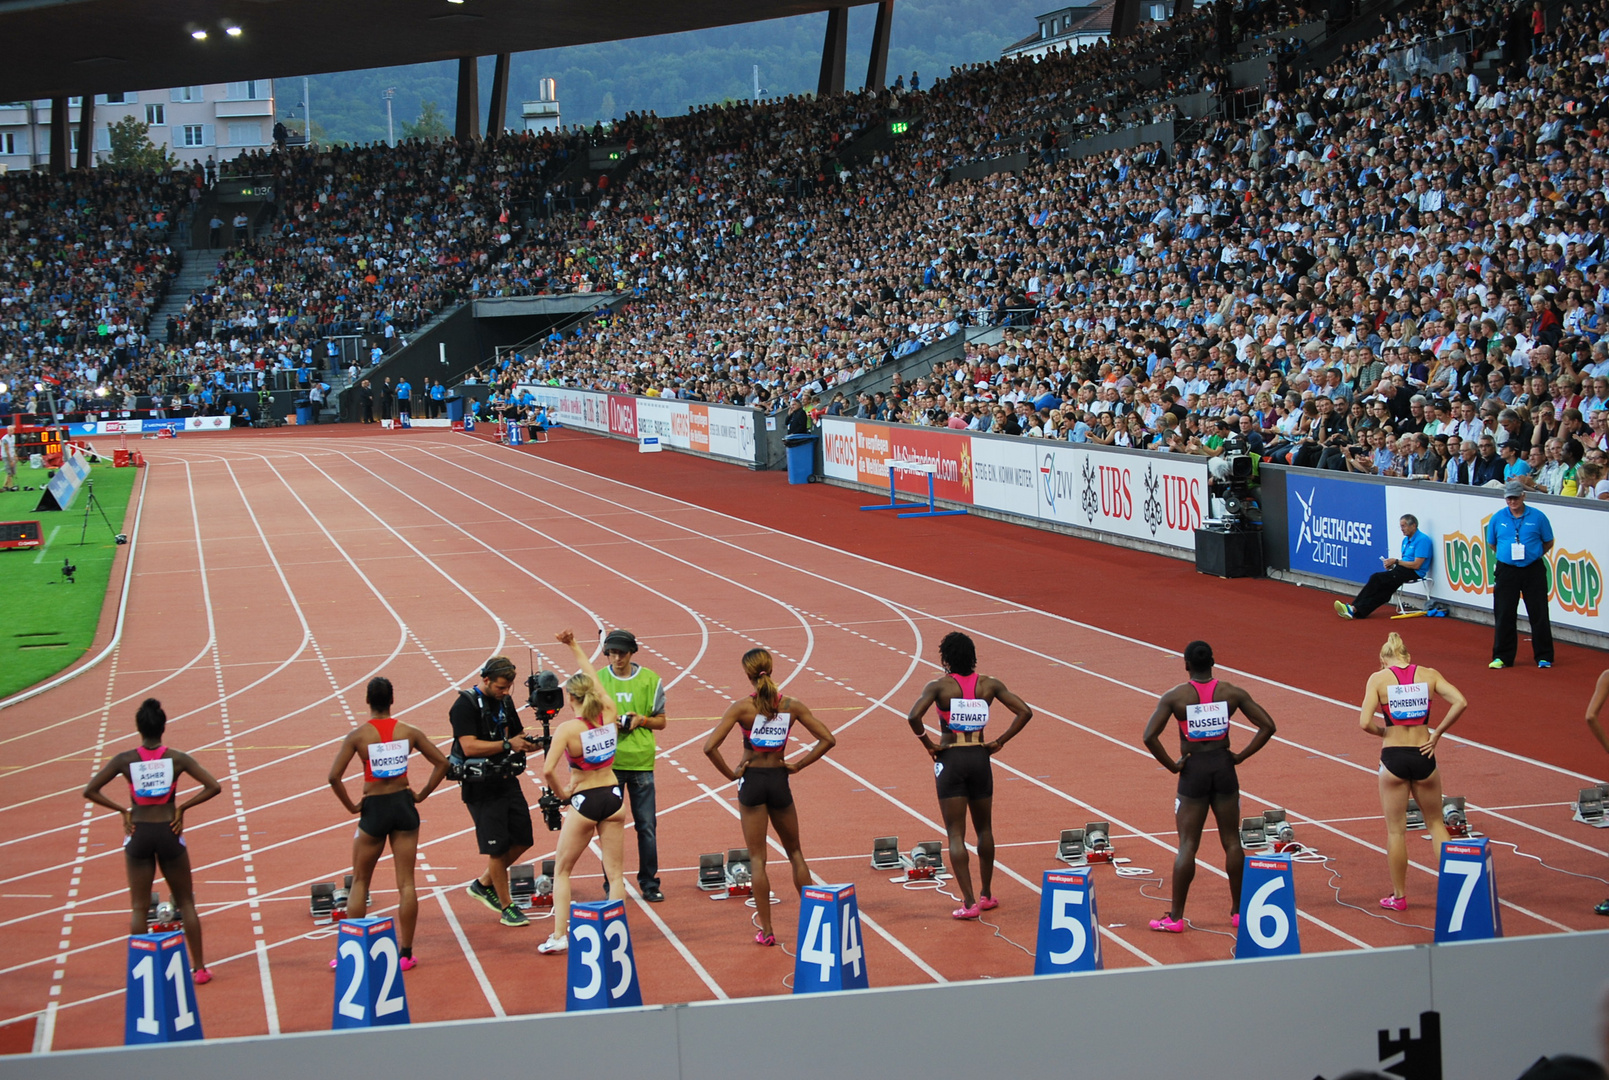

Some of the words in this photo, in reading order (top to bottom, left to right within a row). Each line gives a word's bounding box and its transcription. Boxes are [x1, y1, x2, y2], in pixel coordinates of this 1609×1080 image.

[466, 416, 474, 428] 3
[616, 404, 635, 434] OMEGA
[825, 432, 855, 467] MIGROS
[857, 432, 866, 448] Wir
[1056, 470, 1072, 500] ZVV
[1099, 465, 1133, 521] UBS
[1163, 474, 1200, 532] UBS
[1312, 516, 1372, 546] WELTKLASSE
[1312, 540, 1348, 568] ZÜRICH
[1445, 537, 1483, 588] UBS
[1556, 555, 1601, 611] CUP
[616, 692, 632, 703] TV
[1390, 698, 1428, 708] POHREBNYAK
[1404, 685, 1420, 693] UBS
[951, 713, 987, 722] STEWART
[1189, 717, 1227, 728] RUSSELL
[1203, 704, 1220, 712] UBS
[586, 738, 615, 754] SAILER
[594, 726, 610, 736] UBS
[372, 754, 408, 767] MORRISON
[386, 743, 402, 751] UBS
[140, 772, 164, 780] ASHER
[1444, 860, 1482, 933] 7
[1049, 889, 1086, 964] 5
[1246, 876, 1289, 949] 6
[801, 905, 835, 982] 4
[841, 903, 862, 978] 4
[573, 924, 602, 1000] 3
[604, 920, 632, 999] 3
[165, 950, 195, 1032] 1
[339, 940, 365, 1020] 2
[369, 936, 404, 1017] 2
[132, 955, 159, 1035] 1
